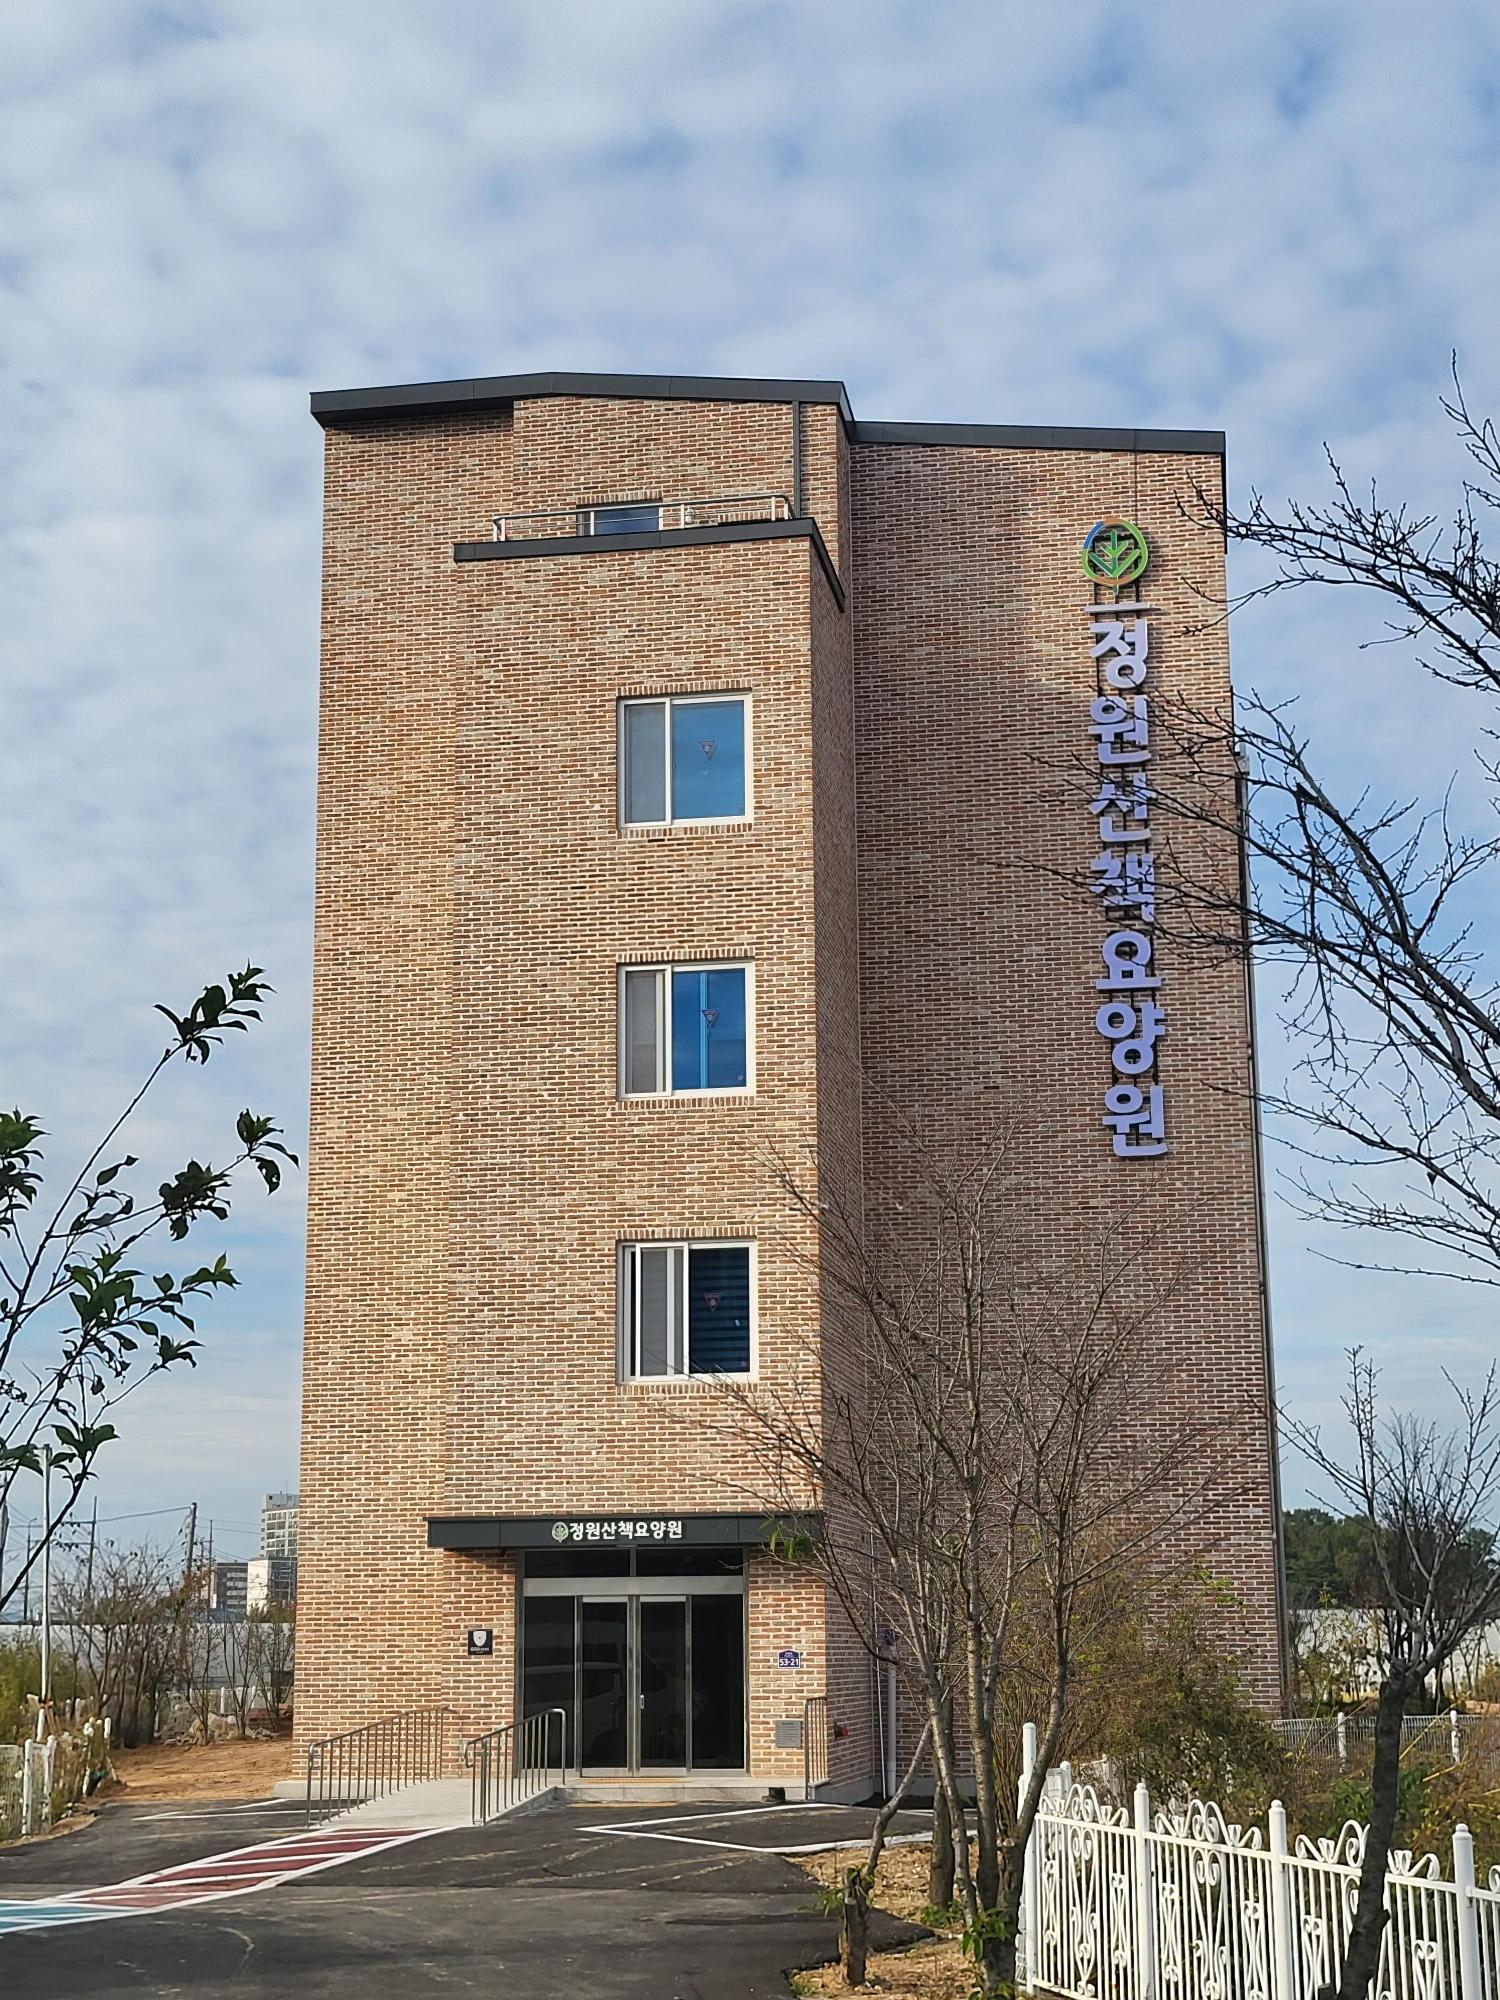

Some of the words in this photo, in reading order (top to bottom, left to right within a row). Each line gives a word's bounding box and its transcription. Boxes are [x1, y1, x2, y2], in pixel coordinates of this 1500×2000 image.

[1088, 619, 1167, 1157] 정원산책요양원
[570, 1520, 682, 1540] 정원산책요양원
[779, 1658, 799, 1666] 53-21
